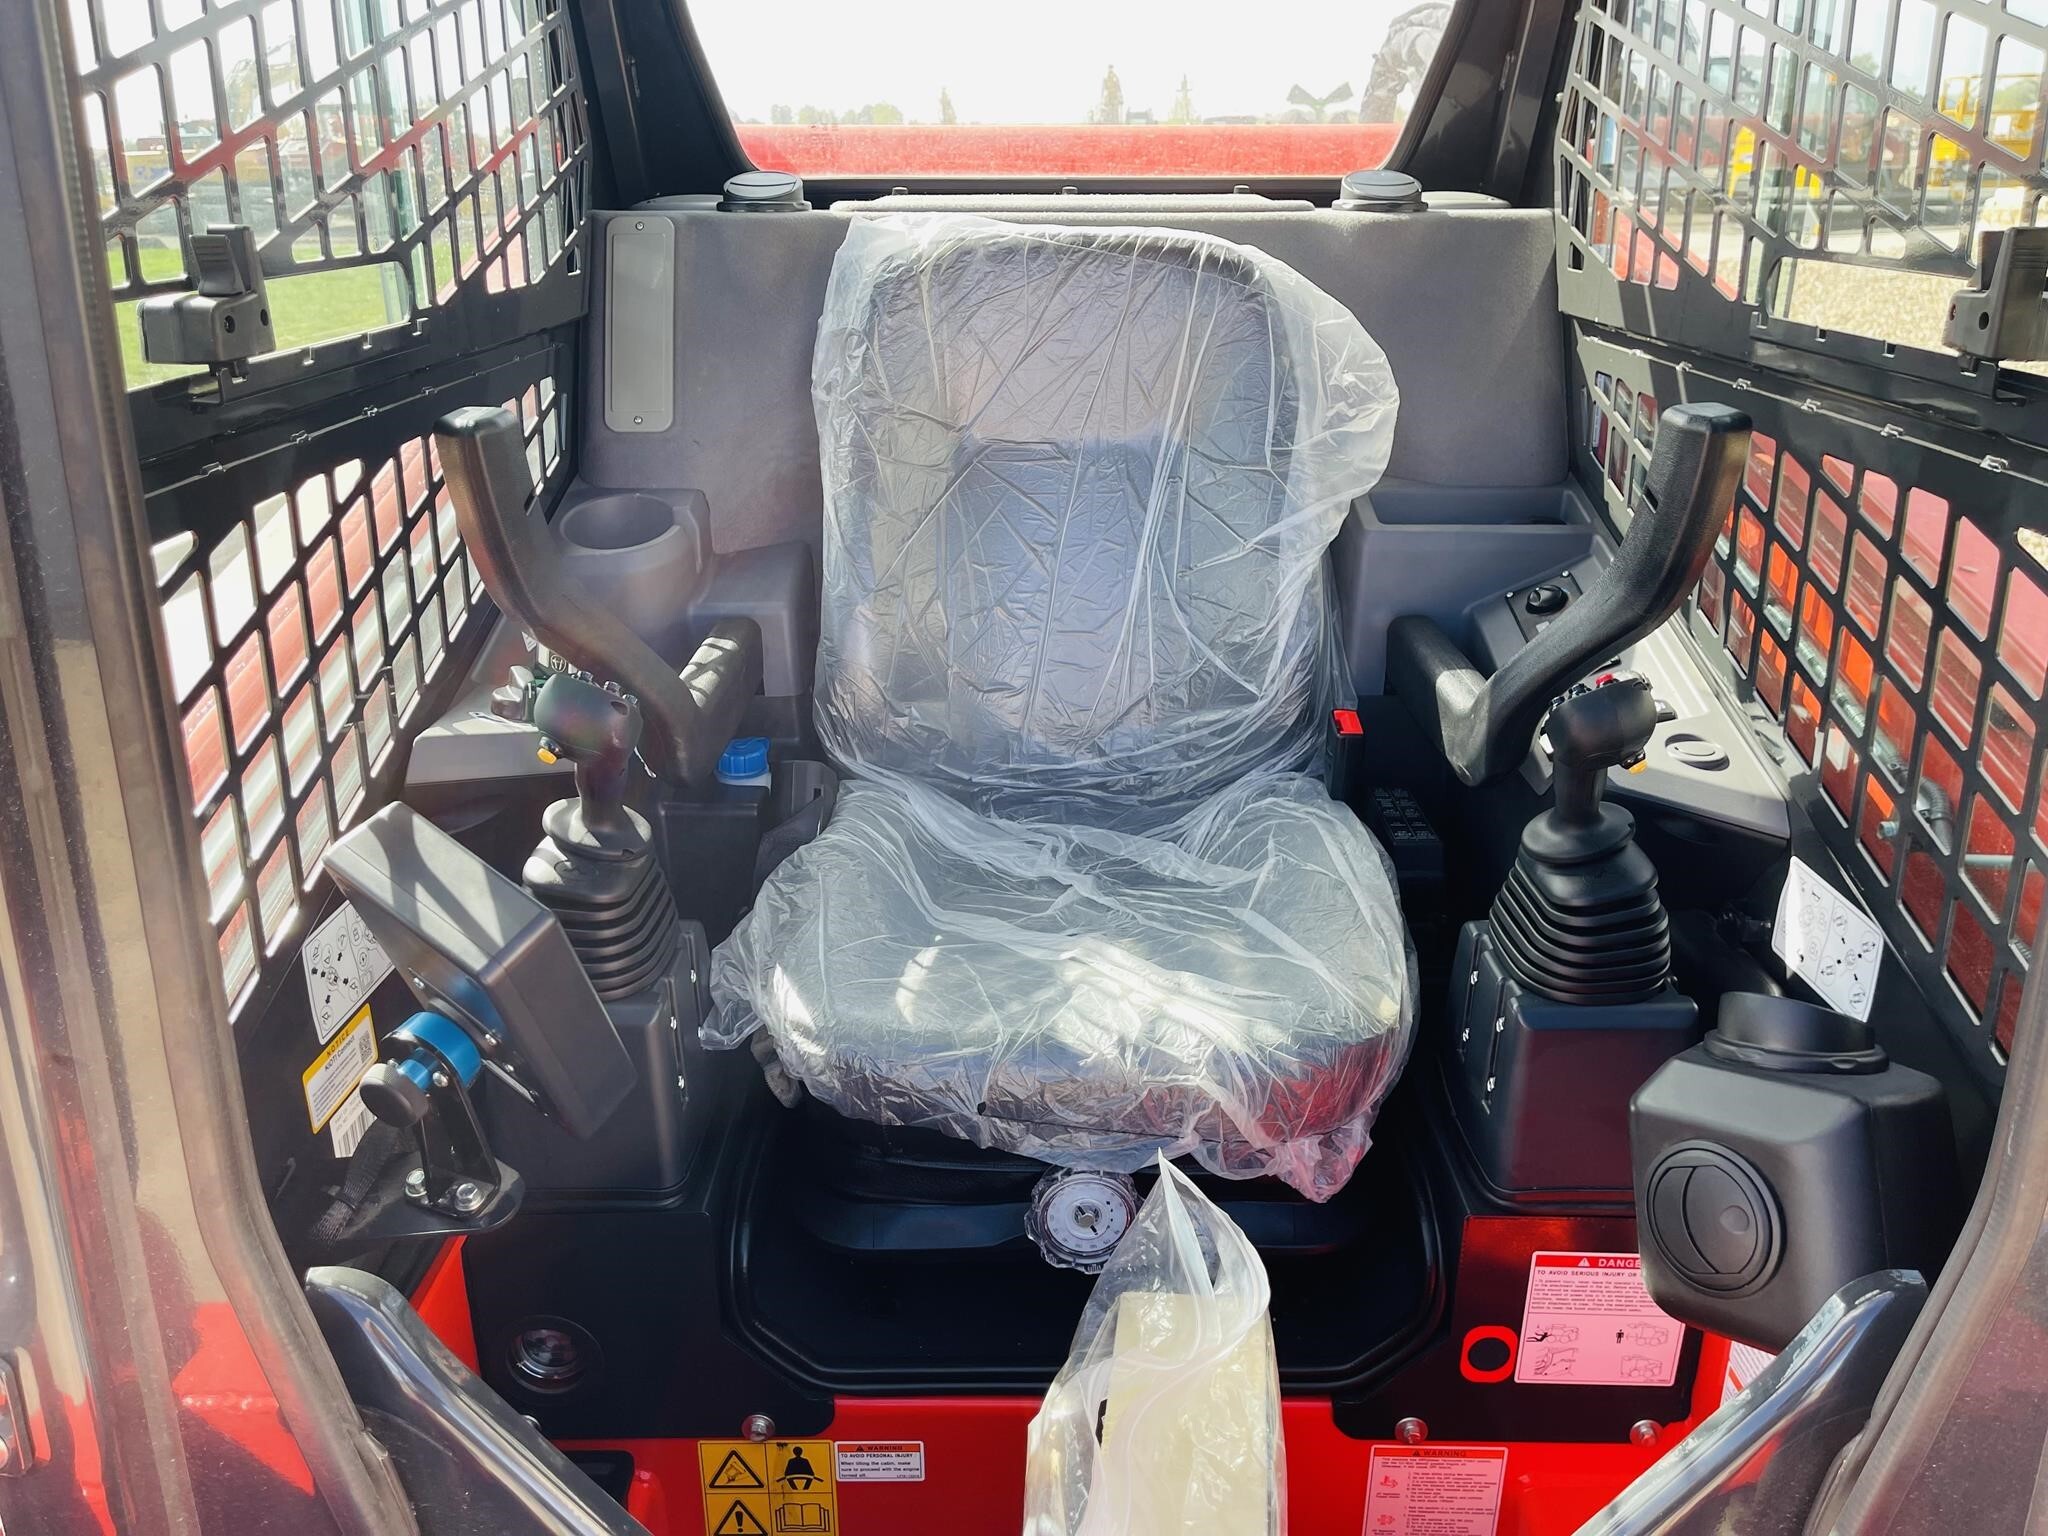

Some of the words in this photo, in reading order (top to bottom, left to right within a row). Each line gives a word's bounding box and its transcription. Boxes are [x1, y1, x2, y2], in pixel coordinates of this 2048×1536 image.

[326, 1029, 350, 1058] NOTICE
[1598, 1258, 1641, 1269] DANGE
[1423, 1449, 1467, 1458] WARNING
